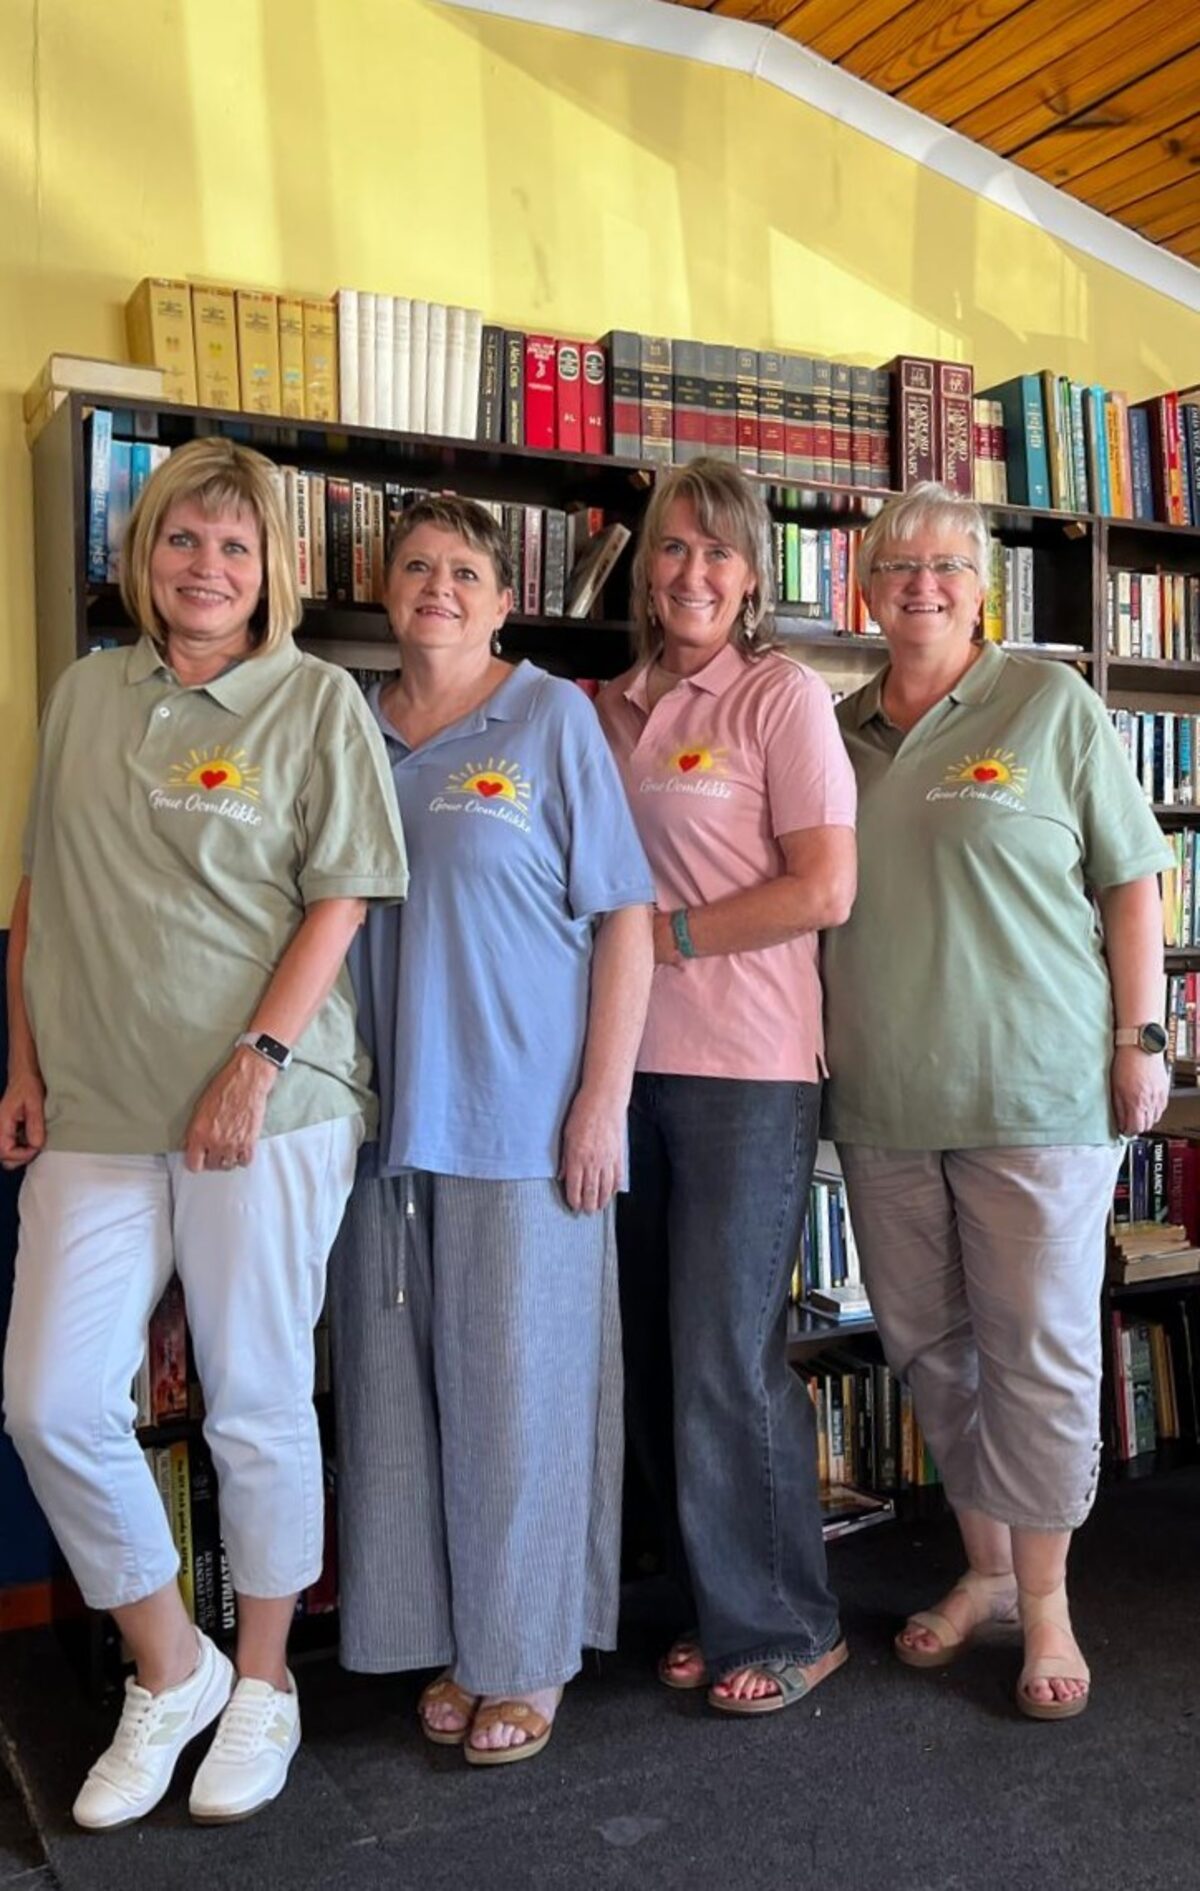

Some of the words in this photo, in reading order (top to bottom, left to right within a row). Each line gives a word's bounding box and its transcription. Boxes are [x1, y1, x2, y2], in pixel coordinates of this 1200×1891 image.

[908, 403, 918, 479] DICTIONARY
[920, 403, 930, 457] OXFORD
[947, 408, 958, 481] DICTIONARY
[958, 408, 969, 462] OXFORD
[297, 479, 305, 494] LEN
[297, 495, 306, 538] DEIGHTON
[355, 503, 363, 545] DEIGHTON
[640, 777, 665, 793] Goue
[666, 776, 732, 799] Oomblikke
[926, 786, 958, 802] Goue
[959, 784, 1027, 812] Oomblikke
[148, 788, 182, 811] Goue
[184, 792, 262, 826] Oomblikke
[429, 796, 462, 812] Goue
[464, 799, 531, 833] Oomblikke
[1154, 1143, 1163, 1161] TOM
[1154, 1162, 1163, 1195] CLANCY
